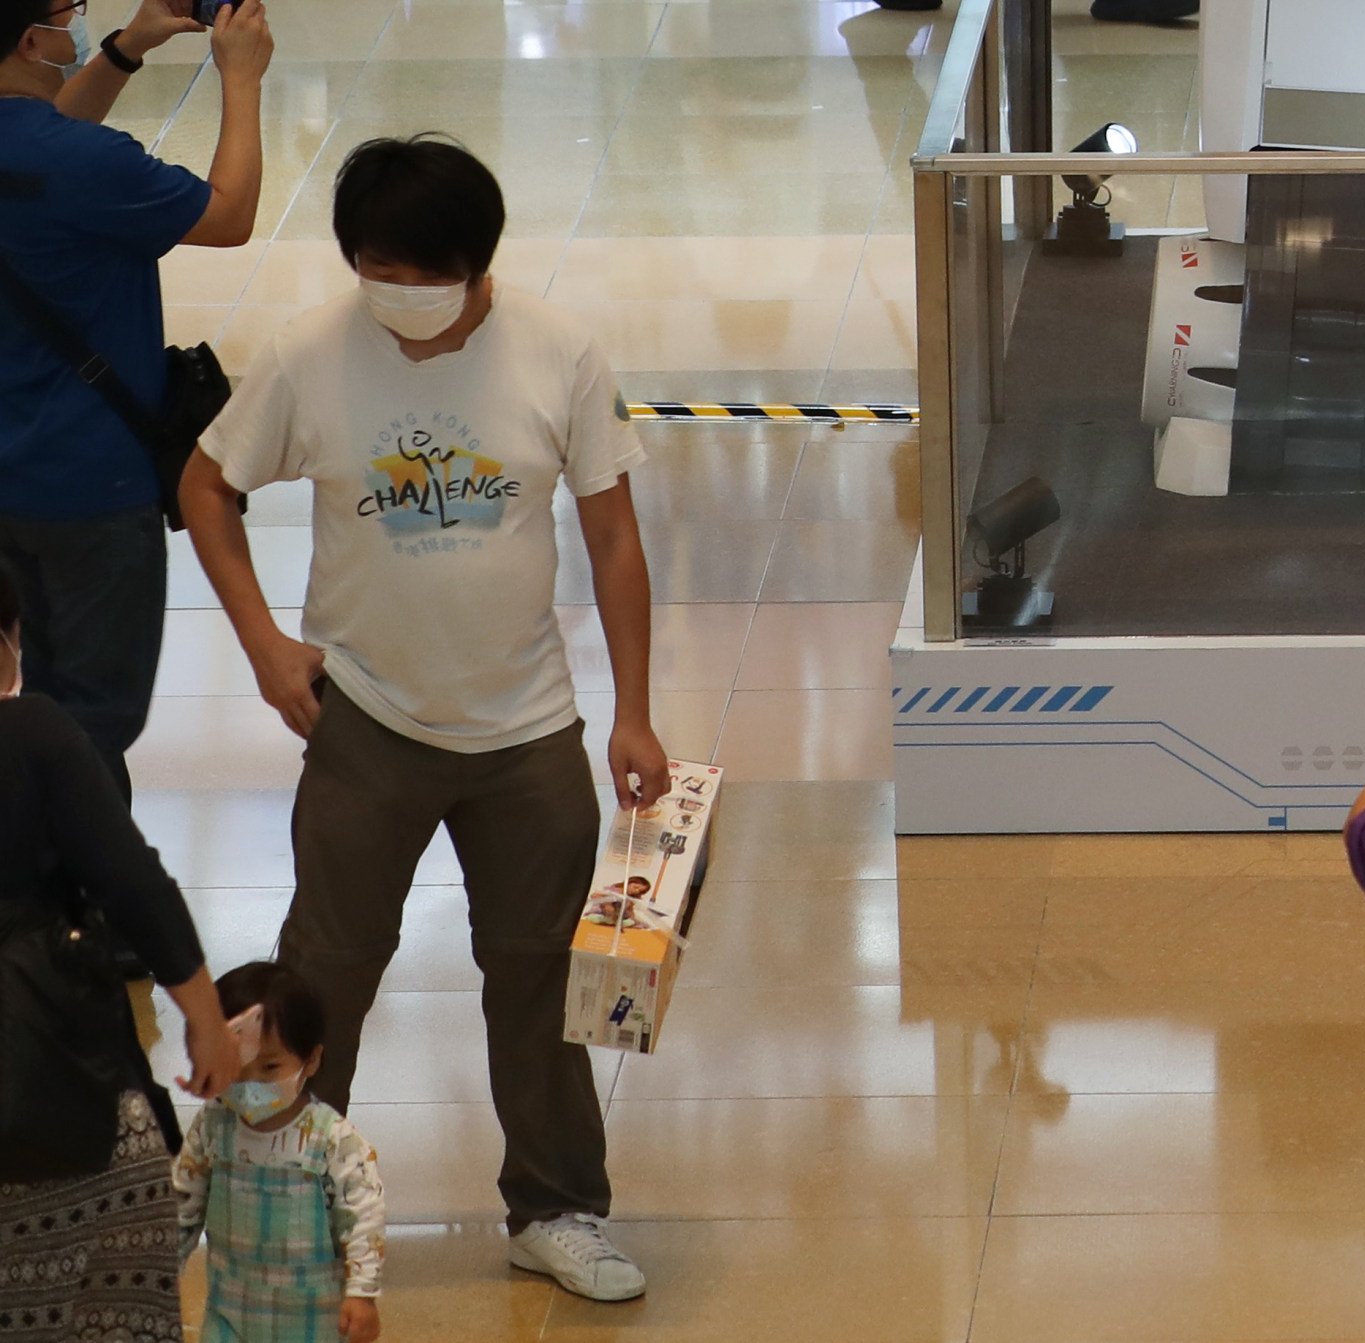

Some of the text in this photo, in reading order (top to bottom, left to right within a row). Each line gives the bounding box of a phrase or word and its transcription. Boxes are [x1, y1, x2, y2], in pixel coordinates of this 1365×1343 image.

[1168, 359, 1180, 398] WARNING
[371, 411, 480, 457] HONG KONG
[357, 474, 521, 529] CHALLENGE
